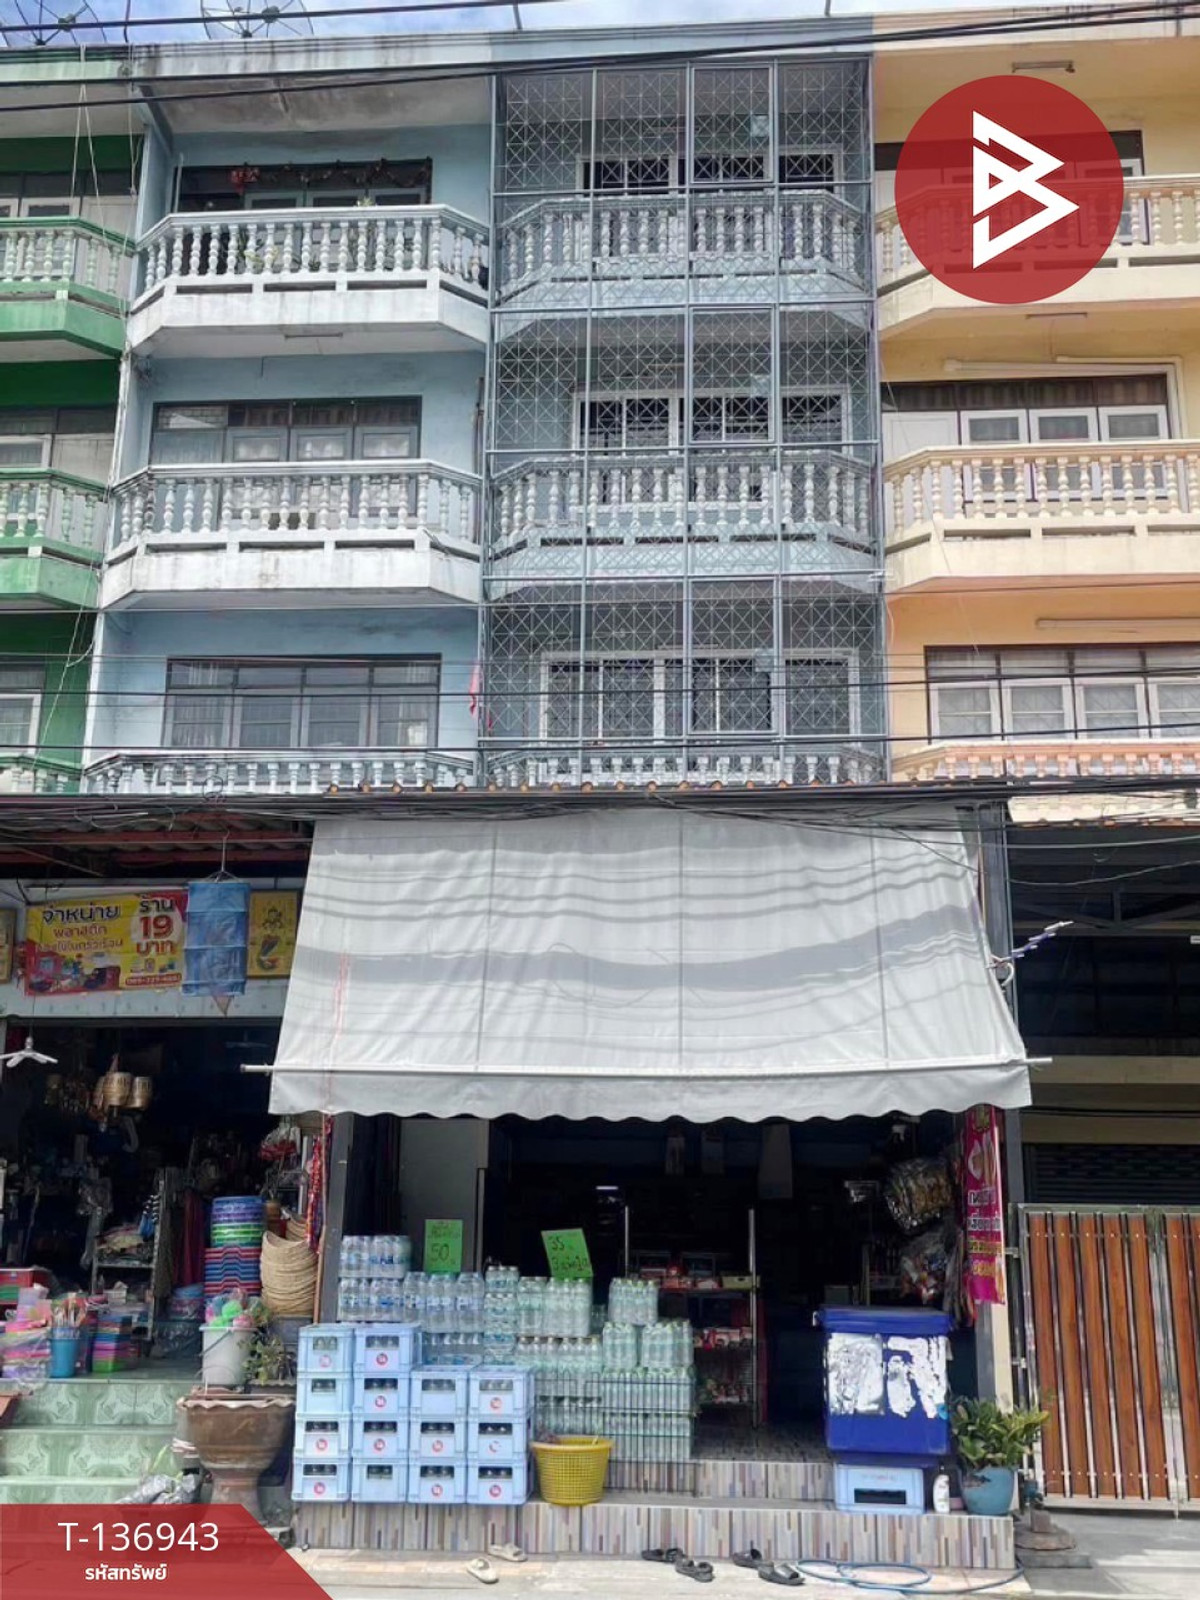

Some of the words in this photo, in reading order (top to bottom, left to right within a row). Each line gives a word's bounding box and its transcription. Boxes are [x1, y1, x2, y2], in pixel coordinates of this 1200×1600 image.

[42, 902, 121, 925] จำหน่าย
[139, 894, 175, 913] ร้าน
[139, 915, 174, 939] 19
[136, 940, 176, 956] บาท
